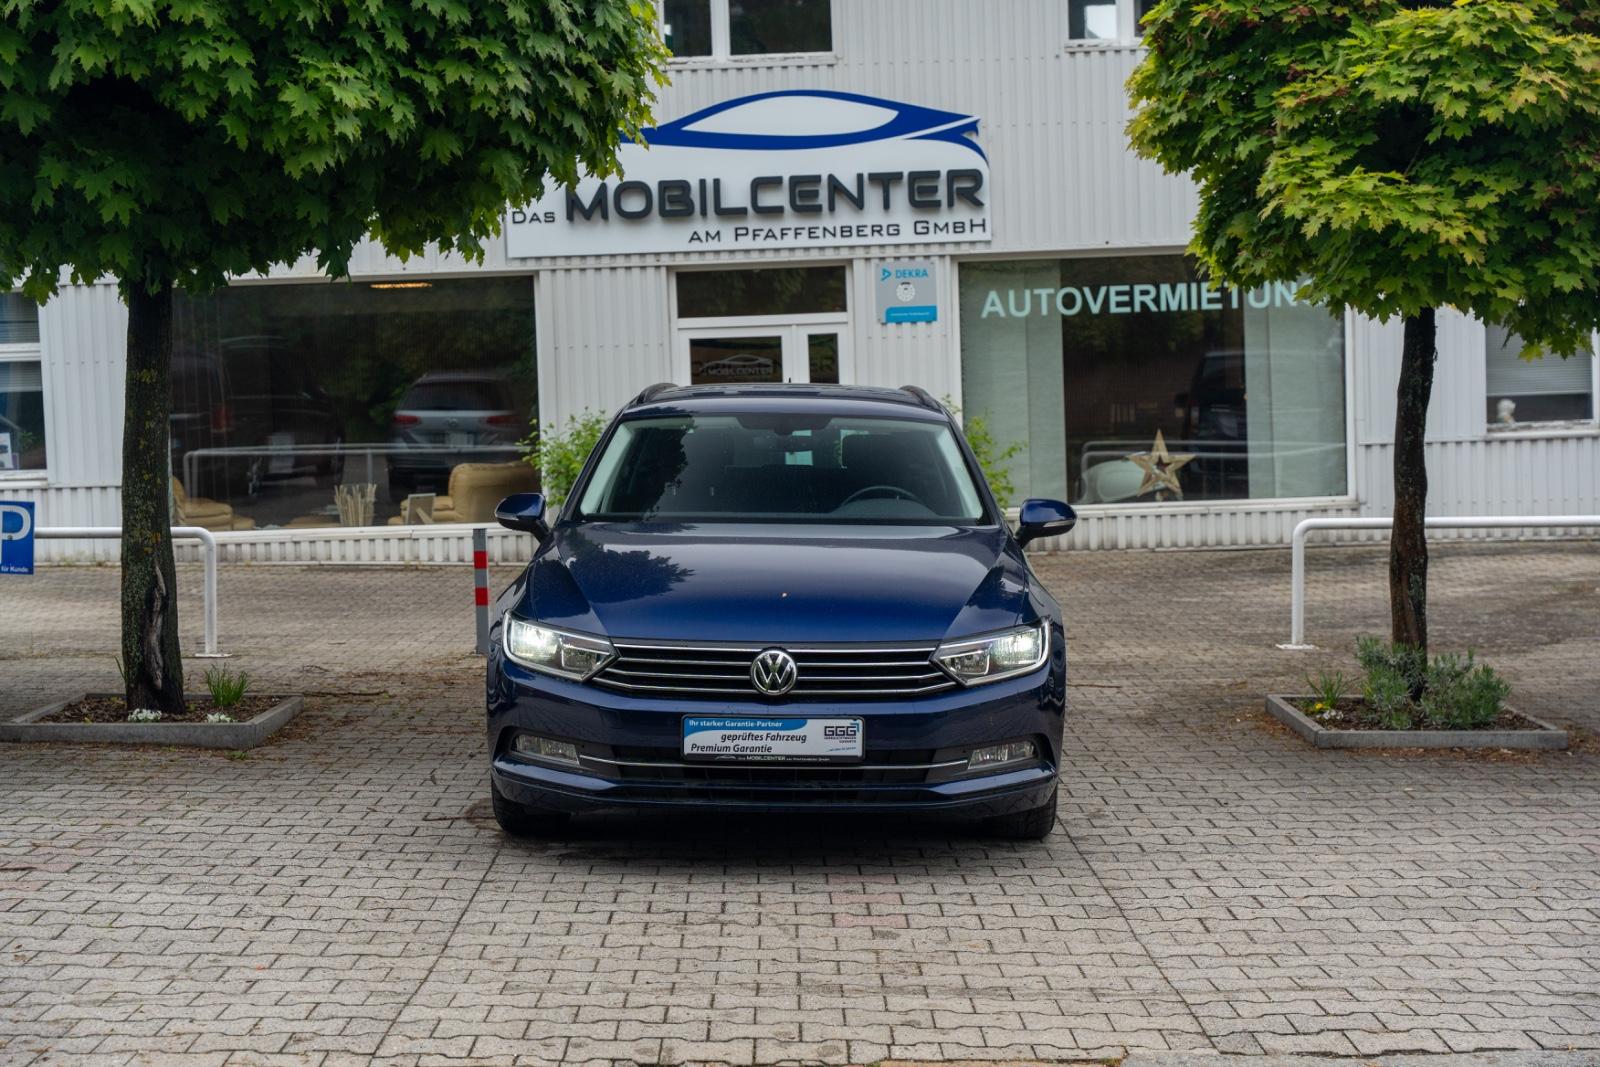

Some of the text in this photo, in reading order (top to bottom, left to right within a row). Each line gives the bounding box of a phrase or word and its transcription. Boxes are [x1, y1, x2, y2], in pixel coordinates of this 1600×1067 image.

[565, 168, 985, 222] MOBILCENTER
[895, 269, 929, 279] DEKRA
[980, 278, 1330, 319] AUTOVERMIETUN
[0, 505, 31, 565] P
[688, 719, 783, 728] Ihr starker Garantie-Partner
[824, 725, 857, 737] GGG
[720, 732, 807, 744] geprüftes Fahrzeug
[690, 743, 773, 753] Premium Garantie
